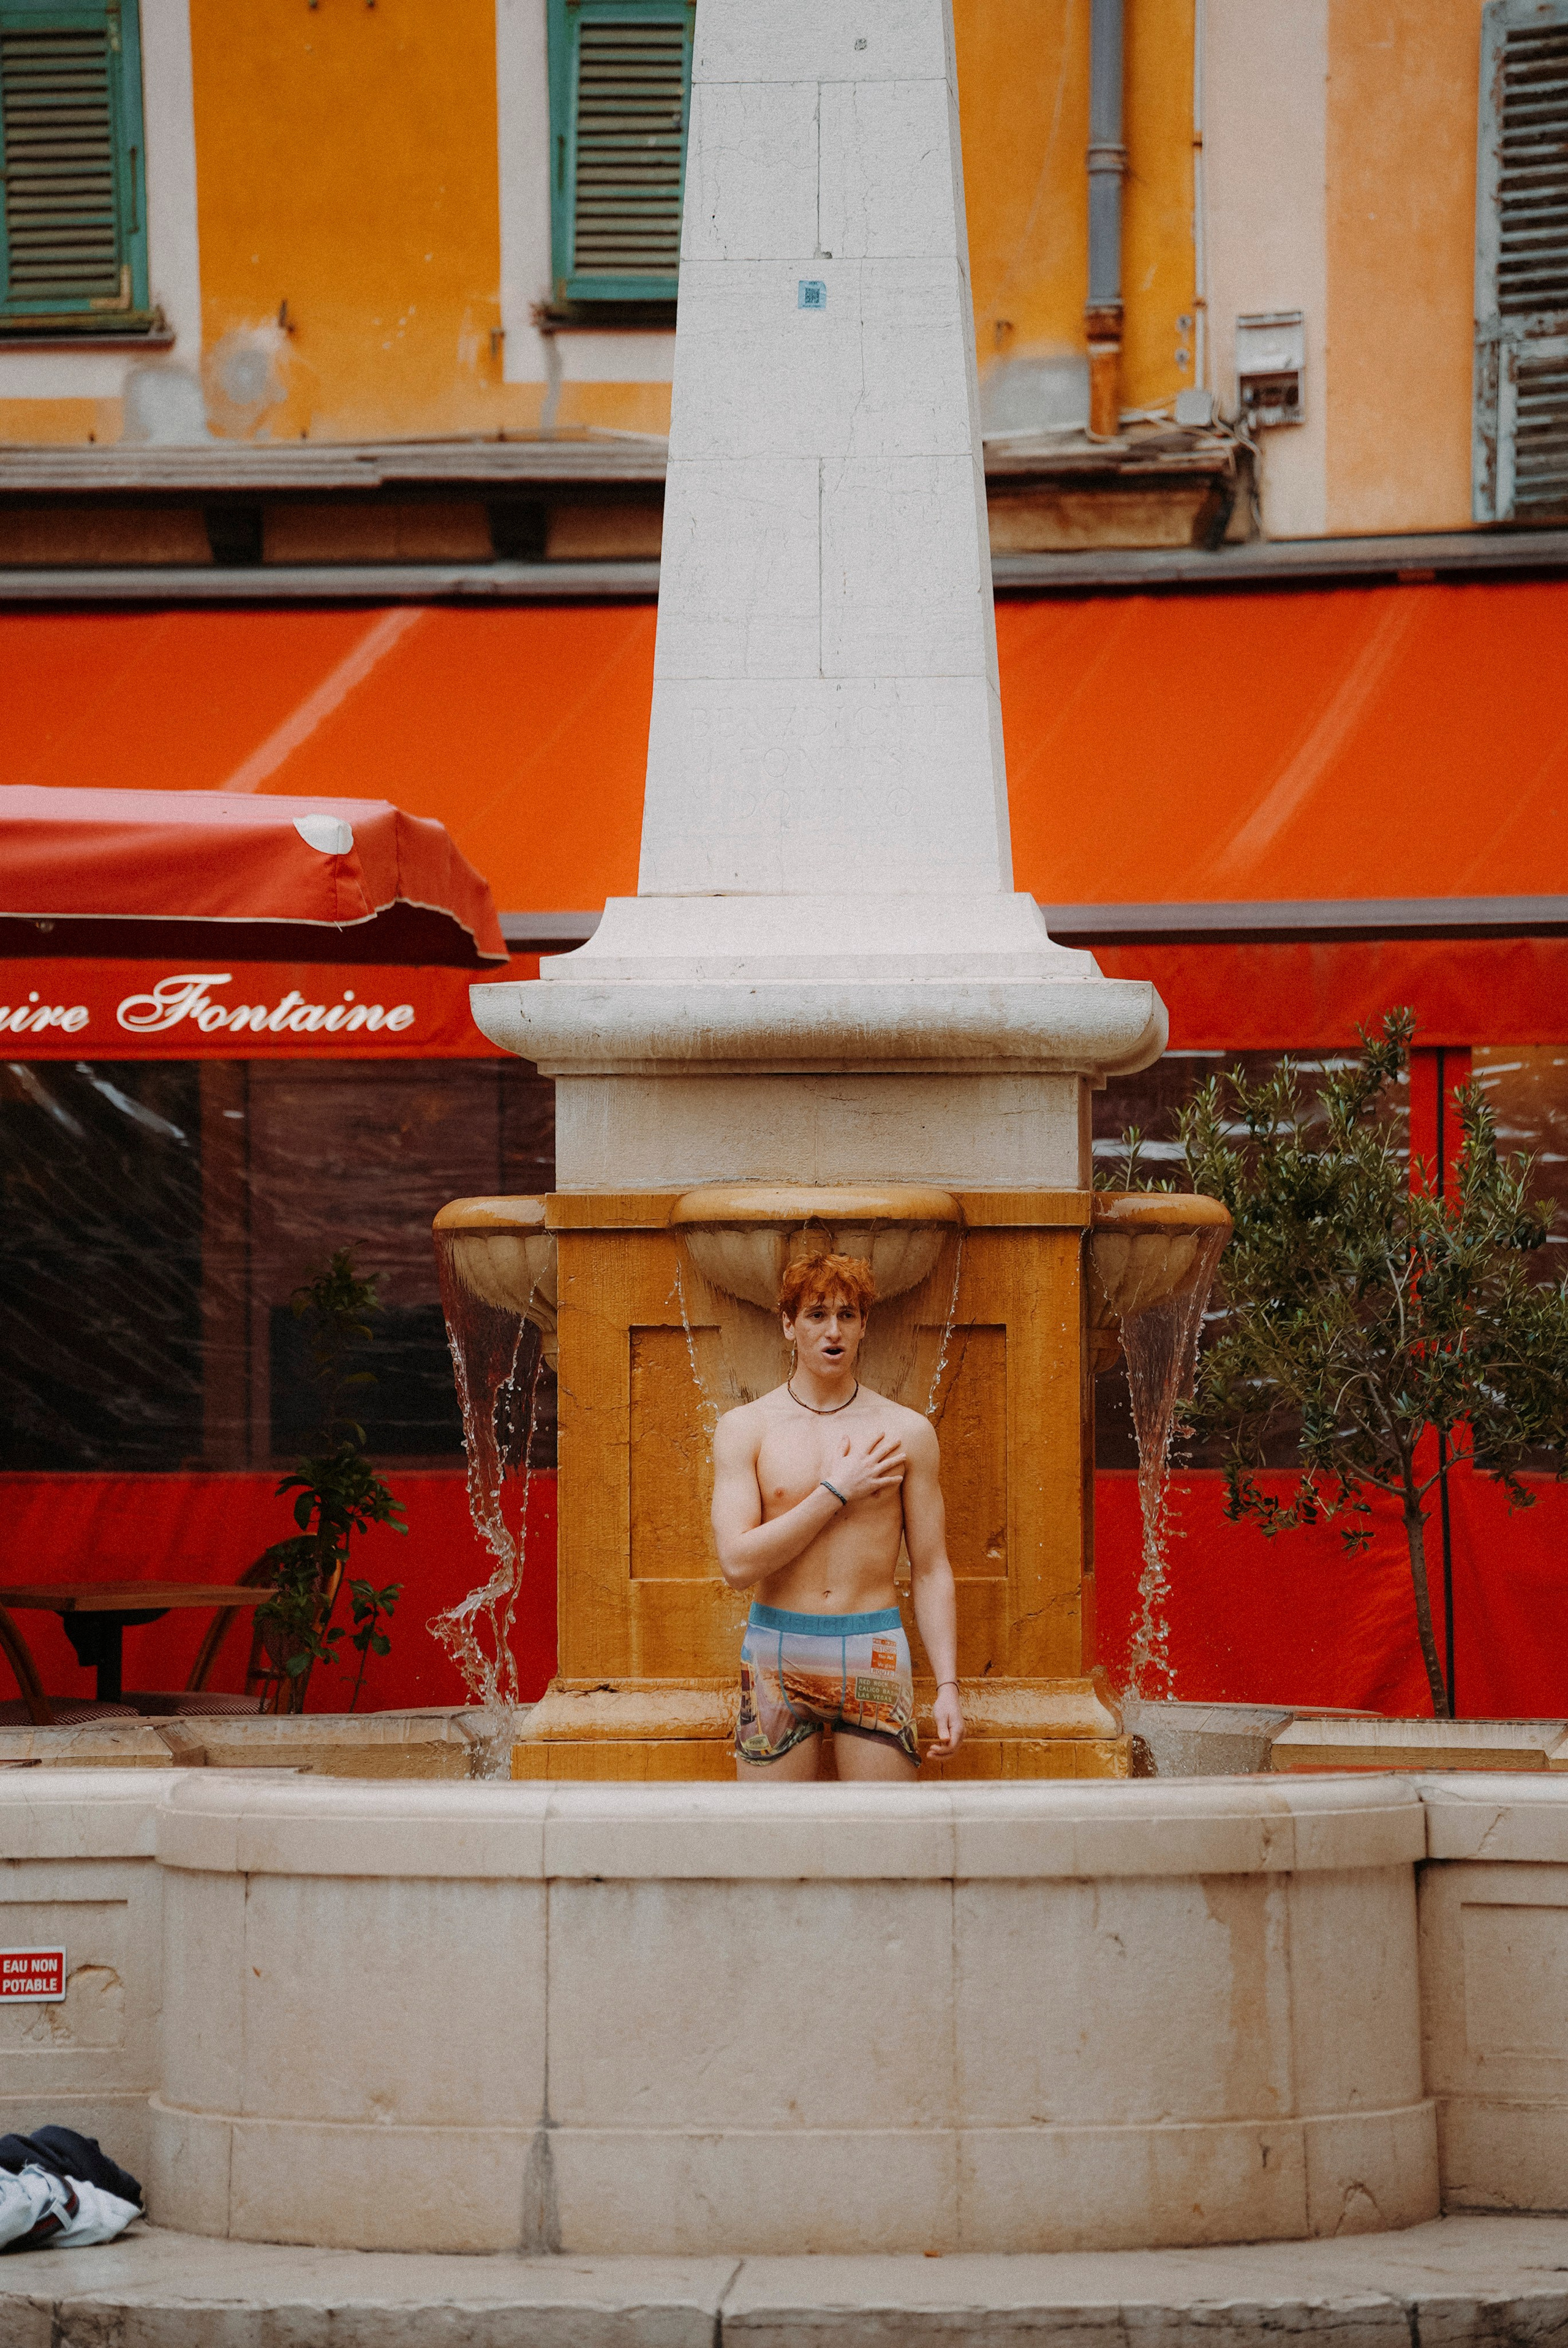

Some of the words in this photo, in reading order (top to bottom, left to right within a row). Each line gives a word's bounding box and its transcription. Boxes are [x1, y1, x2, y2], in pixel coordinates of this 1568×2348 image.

[116, 973, 415, 1032] Fontaine
[3, 1960, 28, 1973] EAU
[31, 1959, 58, 1972] NON
[2, 1977, 58, 1993] POTABLE
